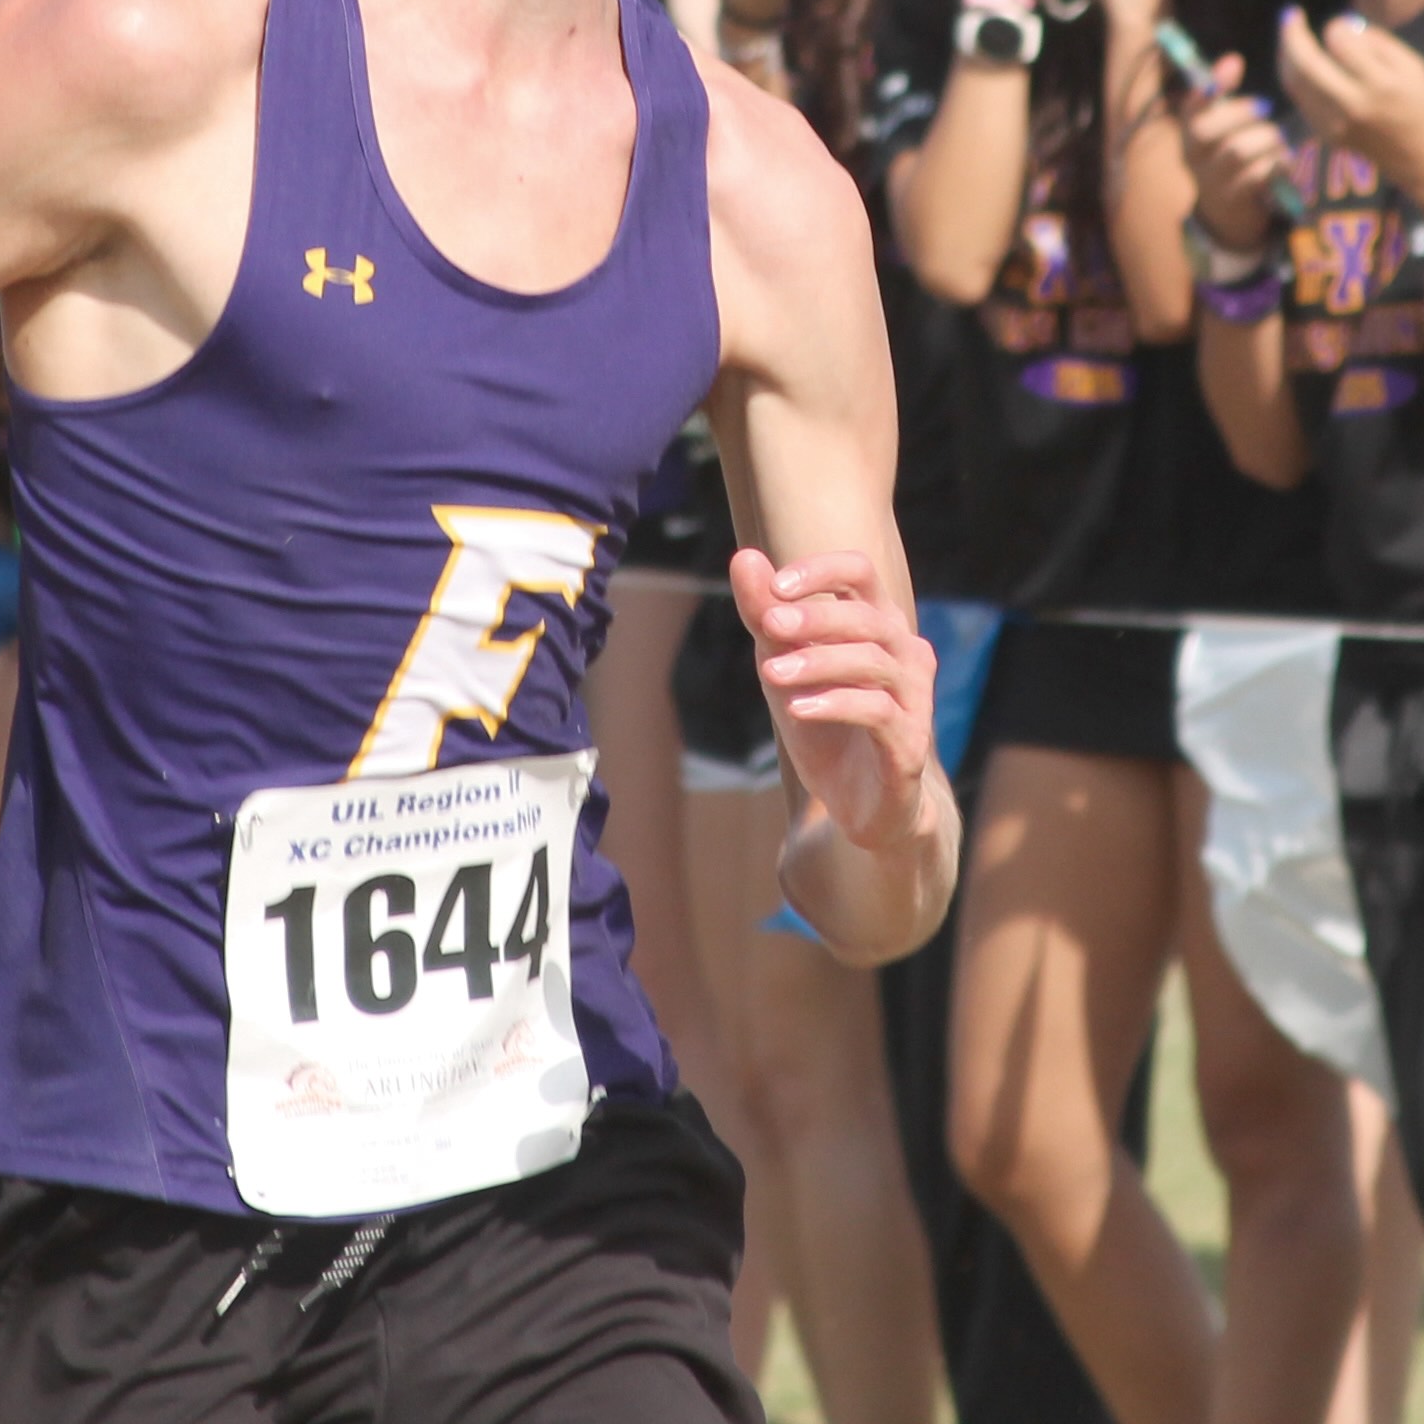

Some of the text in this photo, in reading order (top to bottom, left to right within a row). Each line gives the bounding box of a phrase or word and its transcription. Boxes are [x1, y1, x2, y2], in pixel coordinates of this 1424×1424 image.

[331, 795, 384, 823] UIL
[396, 781, 501, 816] Region
[288, 804, 542, 864] XC Championship
[264, 842, 550, 1025] 1644
